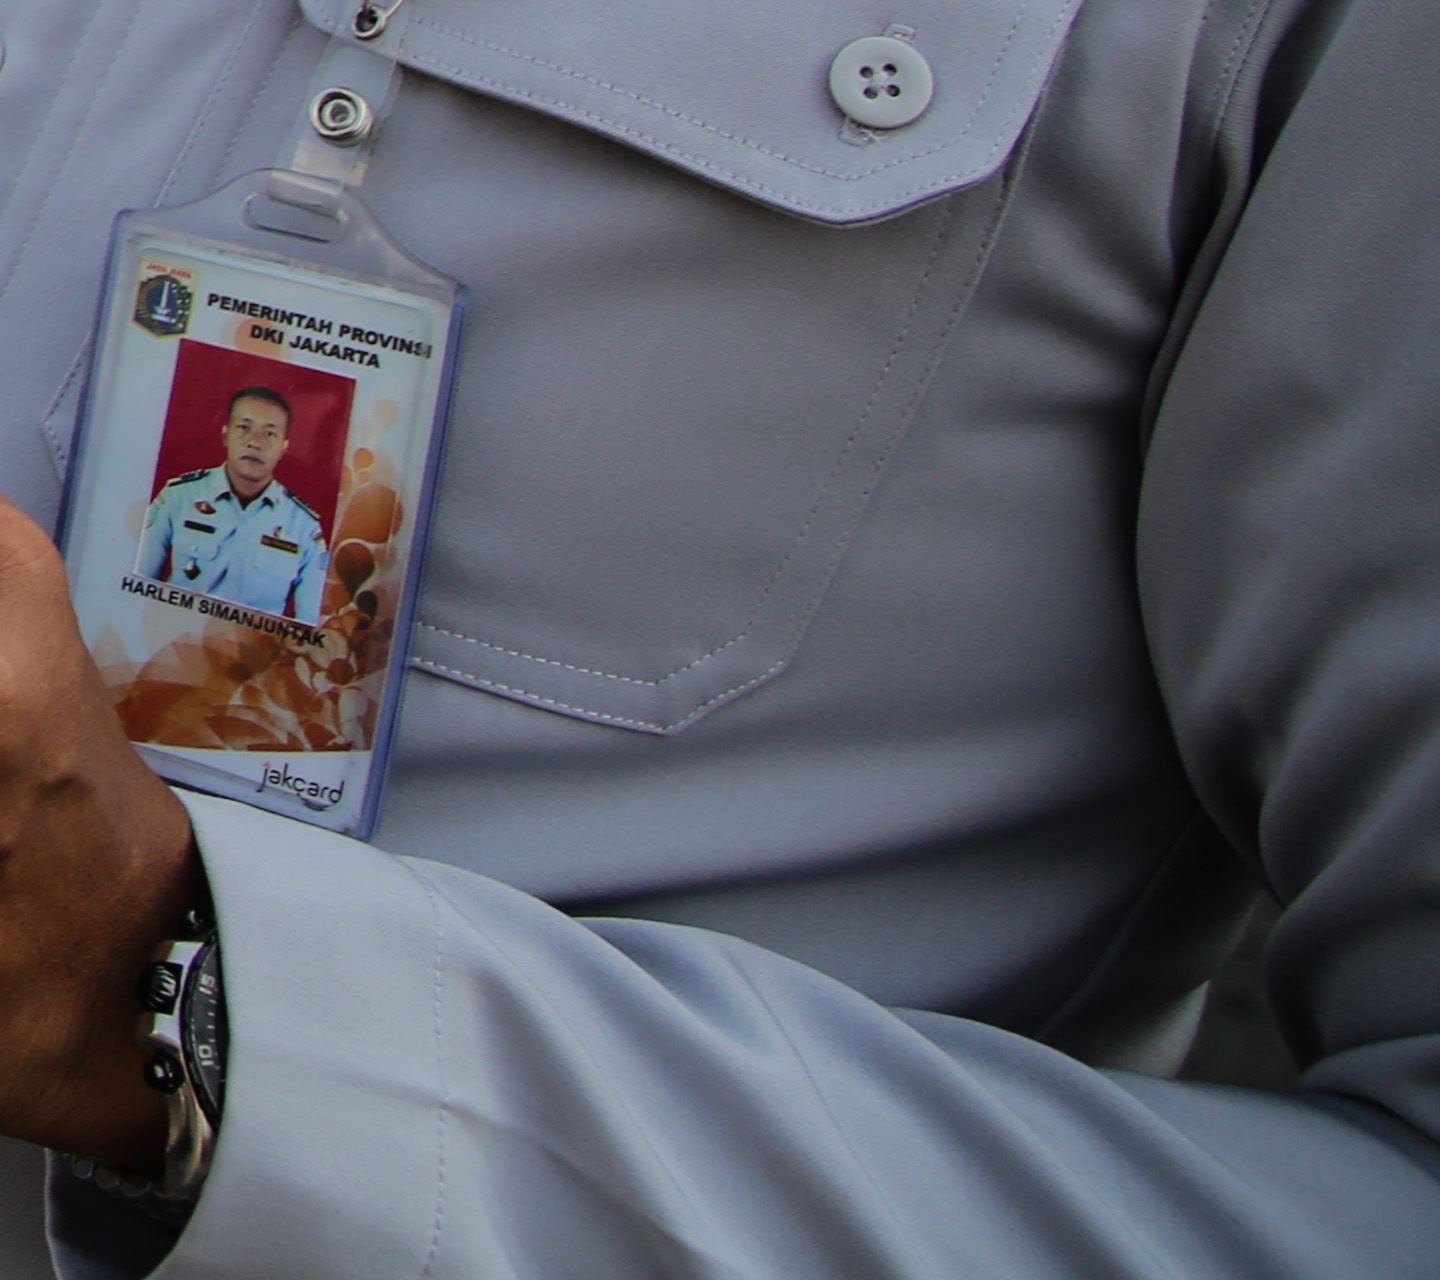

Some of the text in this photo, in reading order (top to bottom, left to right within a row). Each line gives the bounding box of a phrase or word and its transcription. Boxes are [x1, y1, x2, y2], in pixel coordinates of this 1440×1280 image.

[206, 292, 434, 360] PEMERINTAH PROVINSI
[249, 323, 381, 370] DKI JAKARTA
[120, 576, 328, 649] HARLEM SIMANJUNTAK
